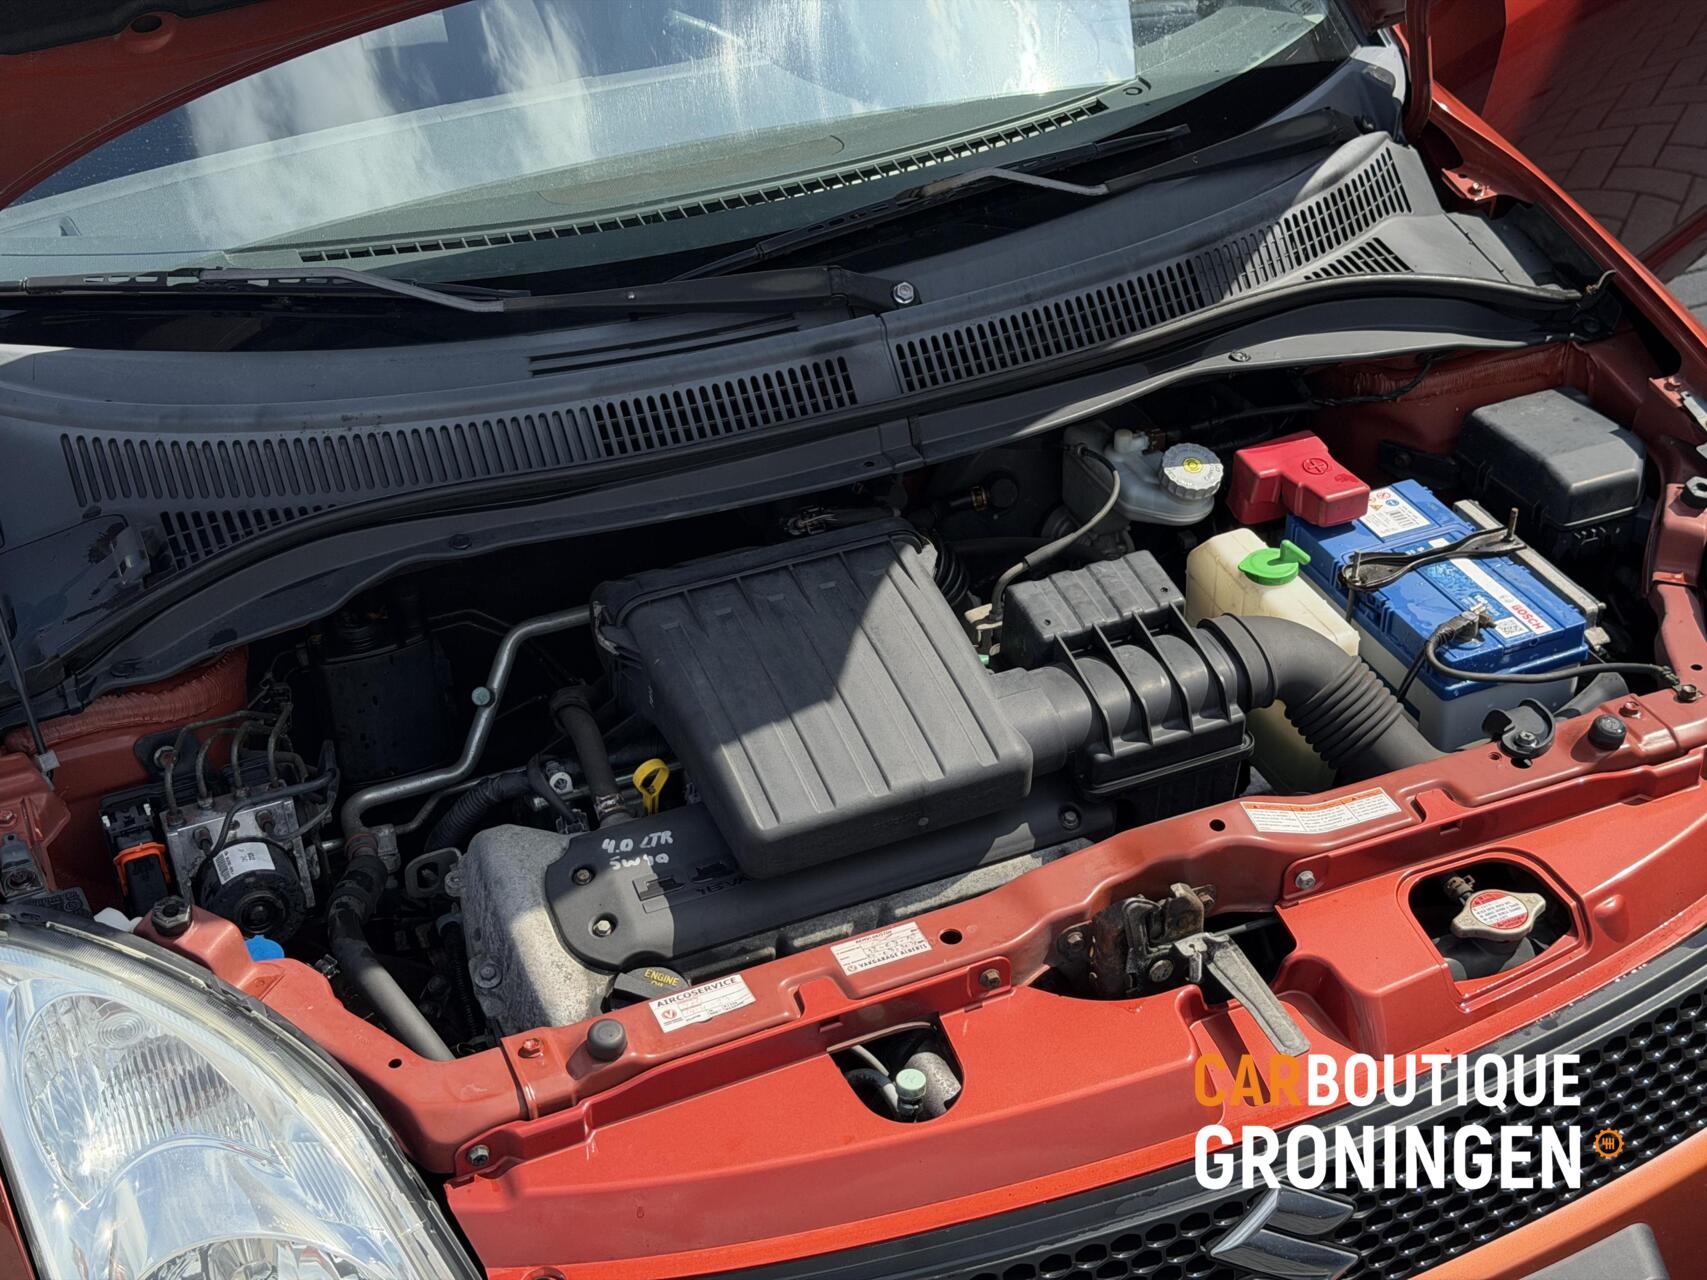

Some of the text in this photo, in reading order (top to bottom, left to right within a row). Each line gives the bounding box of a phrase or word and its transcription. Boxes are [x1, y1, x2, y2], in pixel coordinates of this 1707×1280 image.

[1511, 604, 1546, 631] BOSCH
[602, 830, 674, 853] 4.0 LTR
[644, 968, 680, 987] ENGINE
[656, 977, 737, 1008] AIRCOSERVICE
